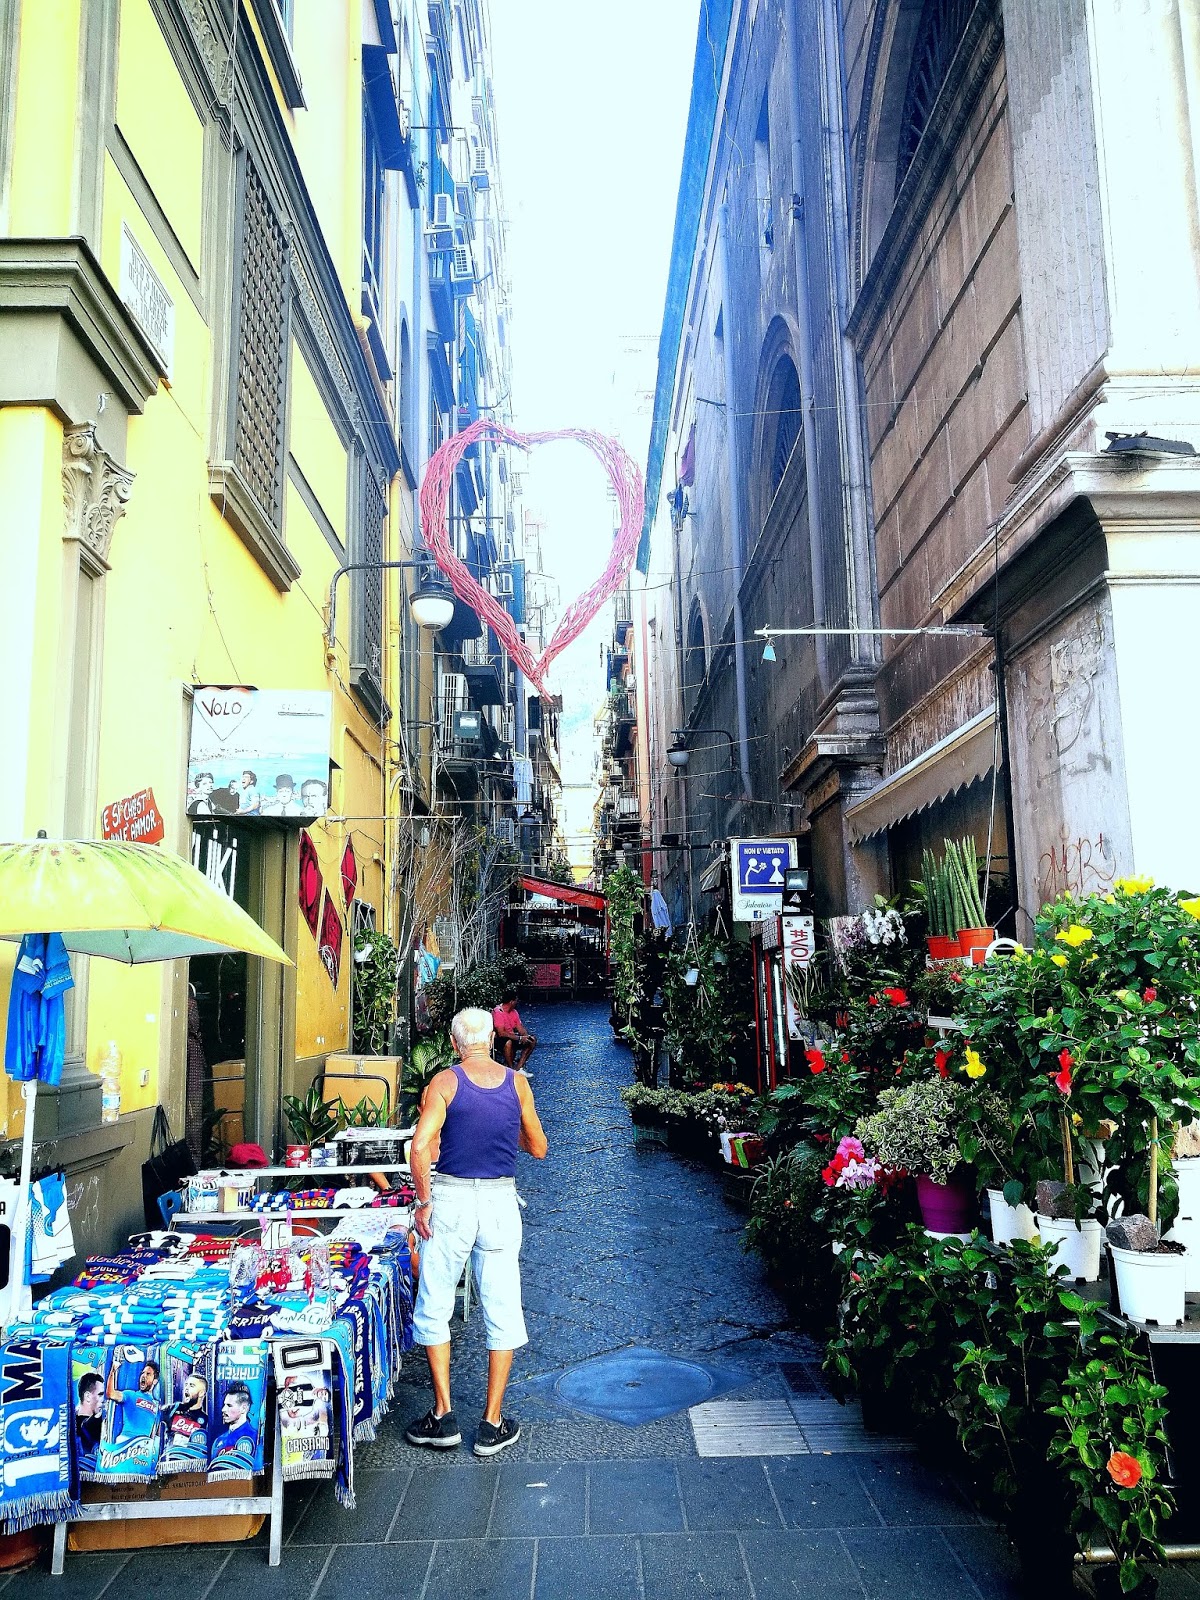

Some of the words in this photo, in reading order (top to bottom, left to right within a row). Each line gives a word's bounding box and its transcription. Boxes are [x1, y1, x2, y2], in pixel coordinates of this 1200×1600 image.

[201, 697, 243, 717] VOLO
[744, 847, 756, 855] NON
[762, 847, 785, 855] VIETATO
[59, 1402, 69, 1458] DIMENTICA
[287, 1436, 330, 1453] CRISTIANO
[101, 1445, 150, 1469] Mertens
